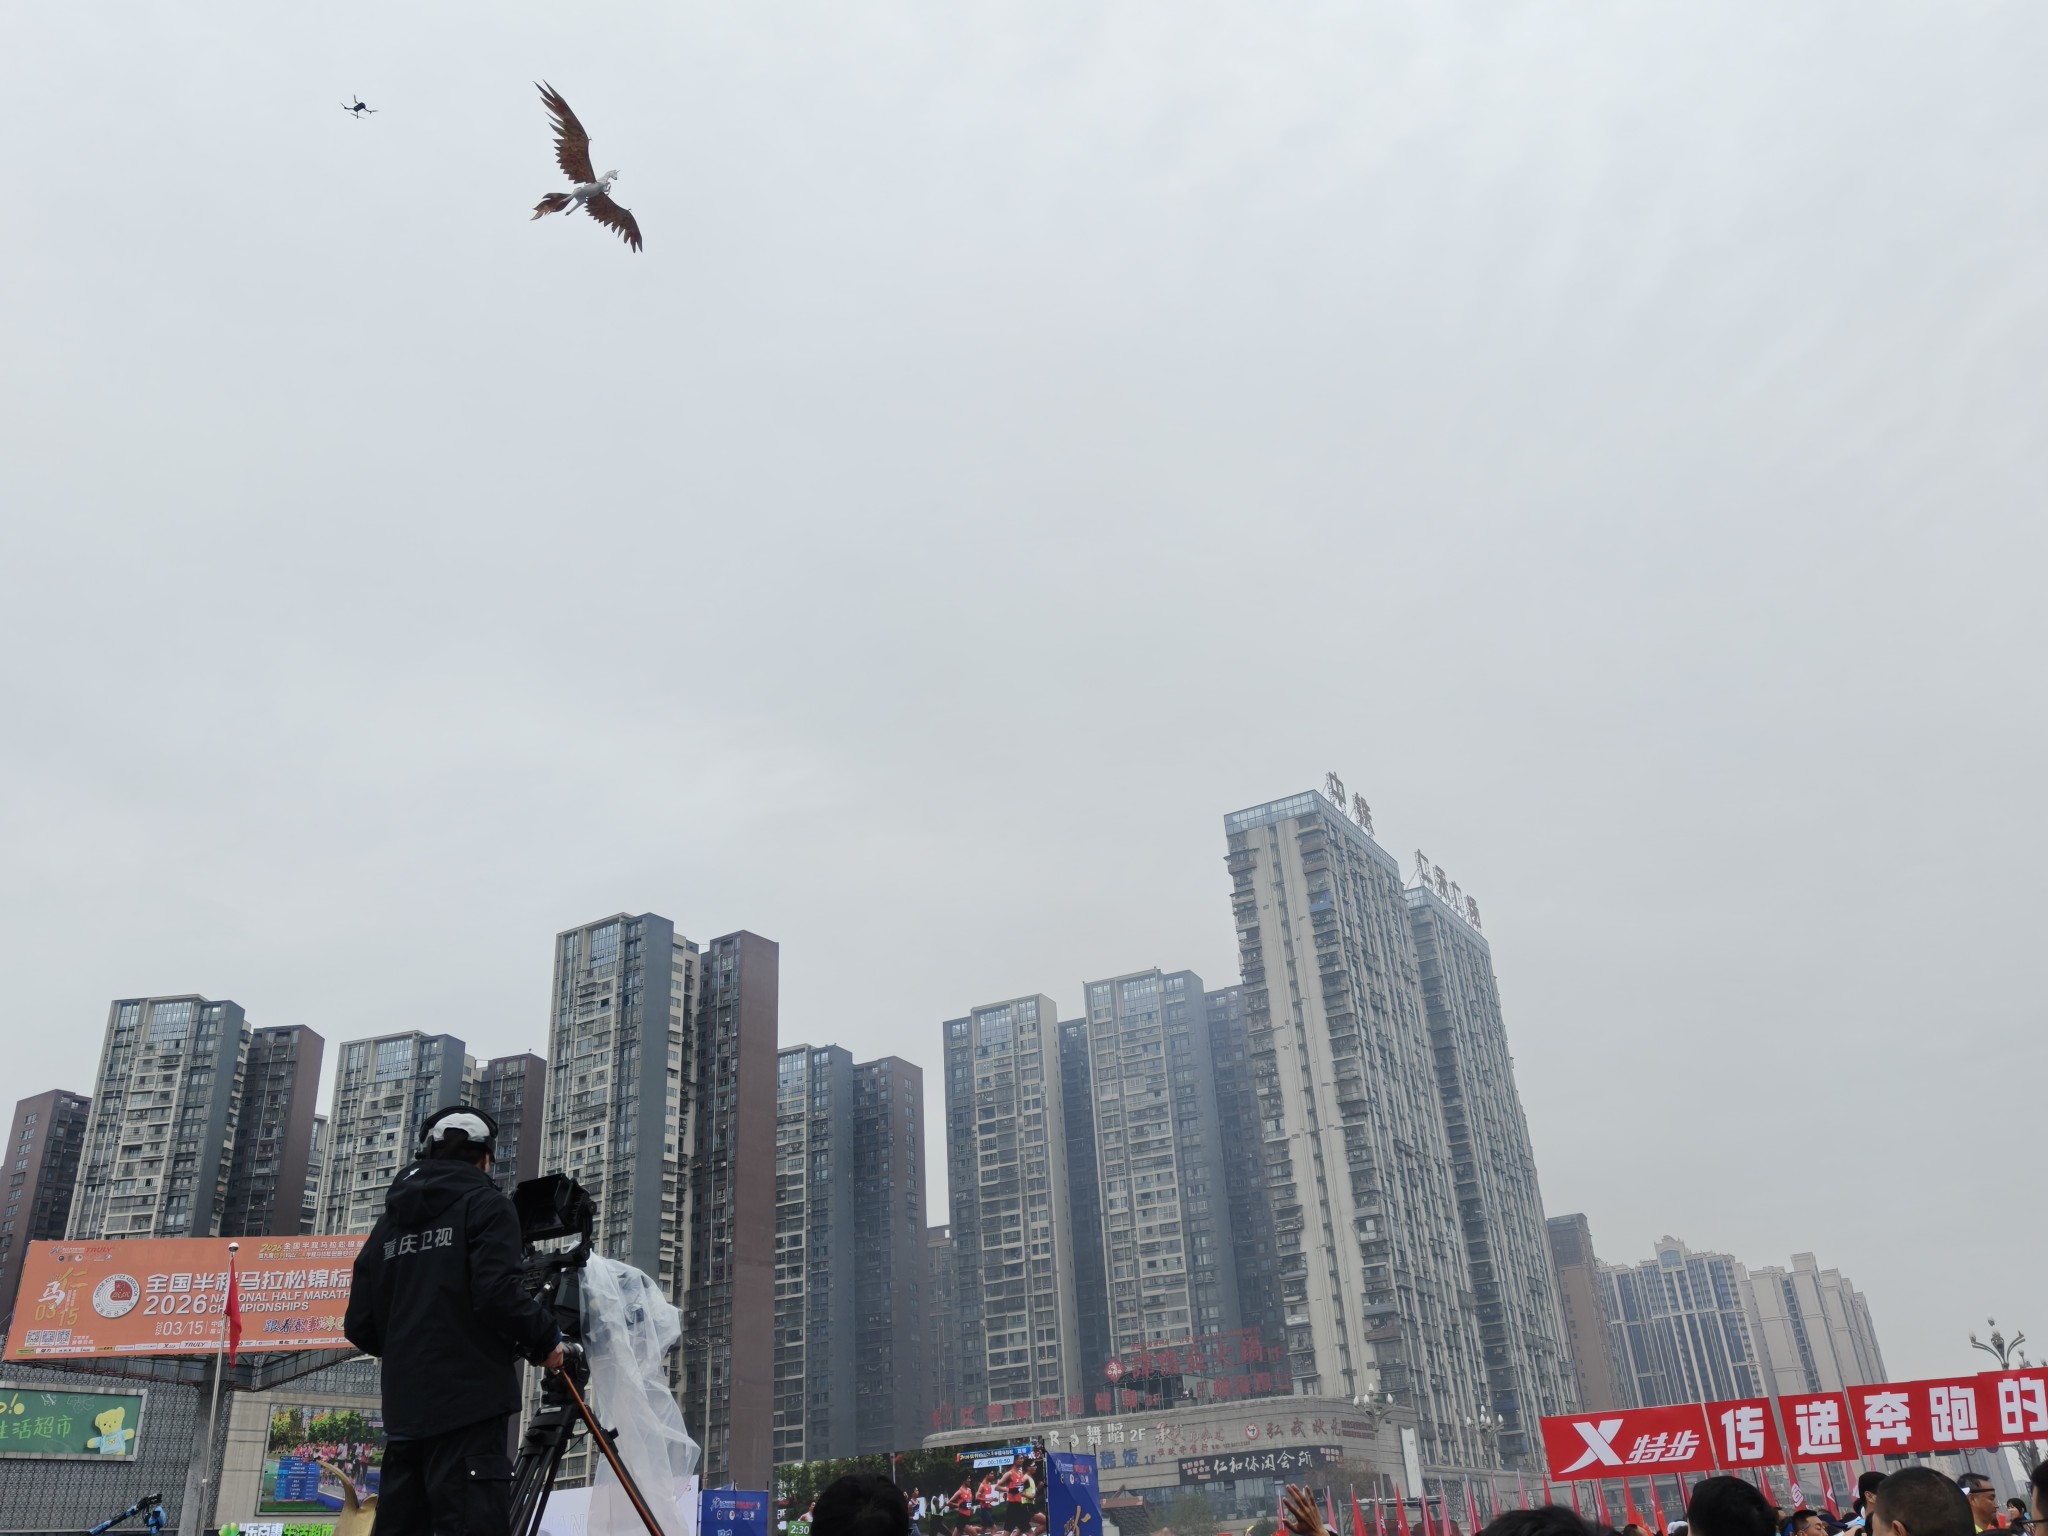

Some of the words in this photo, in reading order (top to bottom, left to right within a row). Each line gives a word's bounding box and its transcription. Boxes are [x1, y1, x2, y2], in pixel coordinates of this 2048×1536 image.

[382, 1227, 453, 1260] 重庆卫视
[143, 1294, 208, 1315] 2026
[210, 1292, 269, 1303] NAONAL
[272, 1291, 302, 1302] HALF
[209, 1302, 309, 1315] CHMPIONSHIPS
[163, 1320, 203, 1336] 03/15
[1625, 1429, 1700, 1465] 特步
[1720, 1376, 2048, 1462] 传递奔跑的
[1086, 1422, 1124, 1446] 舞蹈
[1130, 1428, 1146, 1442] 2F
[1213, 1450, 1313, 1475] 仁和休闲会所
